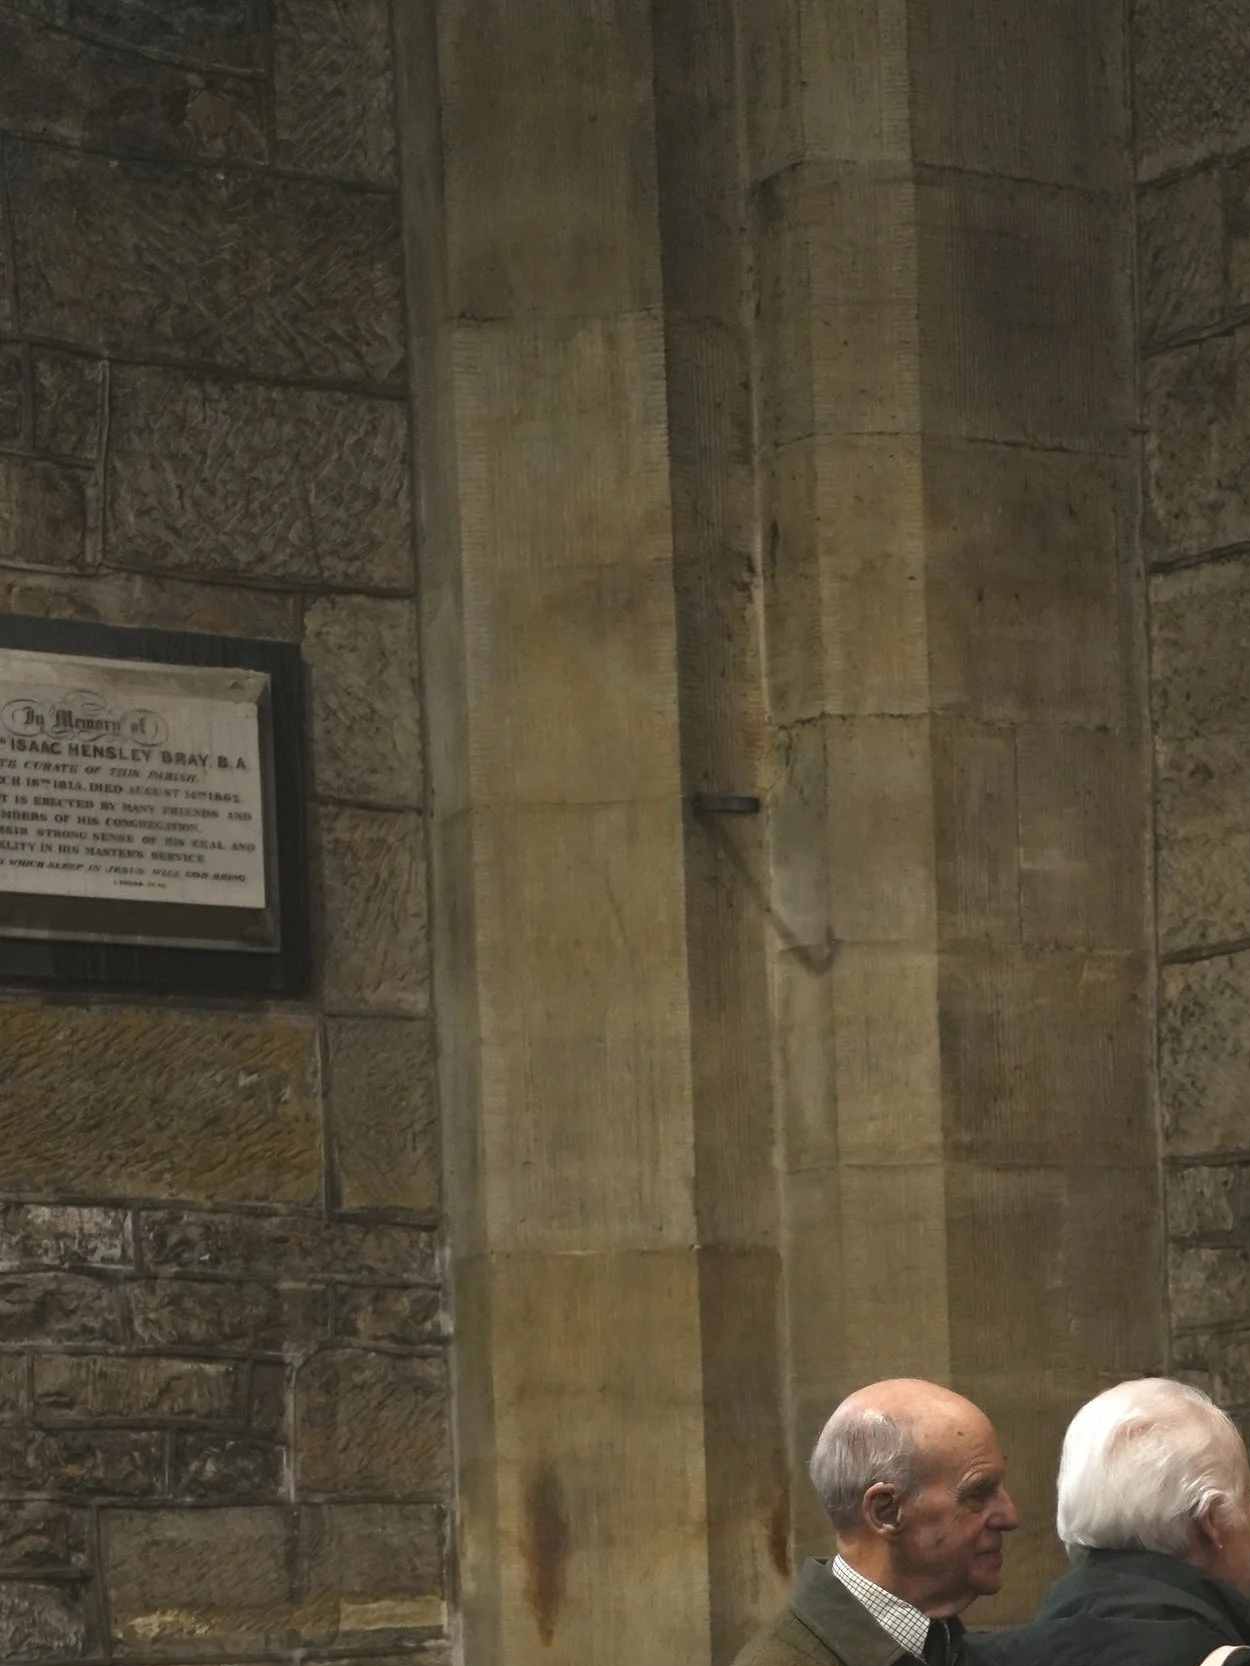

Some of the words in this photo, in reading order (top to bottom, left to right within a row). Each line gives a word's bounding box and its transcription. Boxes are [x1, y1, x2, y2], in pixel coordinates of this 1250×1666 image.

[23, 706, 45, 725] In
[54, 708, 122, 733] Memory
[130, 716, 147, 734] of
[10, 737, 62, 755] ISAAC
[68, 742, 151, 762] HENSLEY
[23, 761, 79, 774] CURATE
[83, 765, 103, 775] OF
[88, 782, 124, 794] DIED
[127, 785, 180, 799] AUGUST
[14, 794, 28, 805] IS
[33, 795, 95, 810] ERECTED
[100, 801, 116, 811] BY
[121, 802, 155, 814] MANY
[161, 805, 219, 819] FRIENDS
[226, 811, 253, 822] AND
[53, 813, 70, 824] OF
[77, 814, 100, 826] HIS
[36, 827, 88, 840] STRONG
[91, 831, 135, 844] SENSE
[141, 835, 158, 845] OF
[164, 836, 186, 847] HIS
[230, 842, 256, 852] AND
[8, 858, 45, 869] WHICH
[40, 843, 53, 853] IN
[58, 843, 80, 854] HIS
[150, 850, 205, 864] SERVICE
